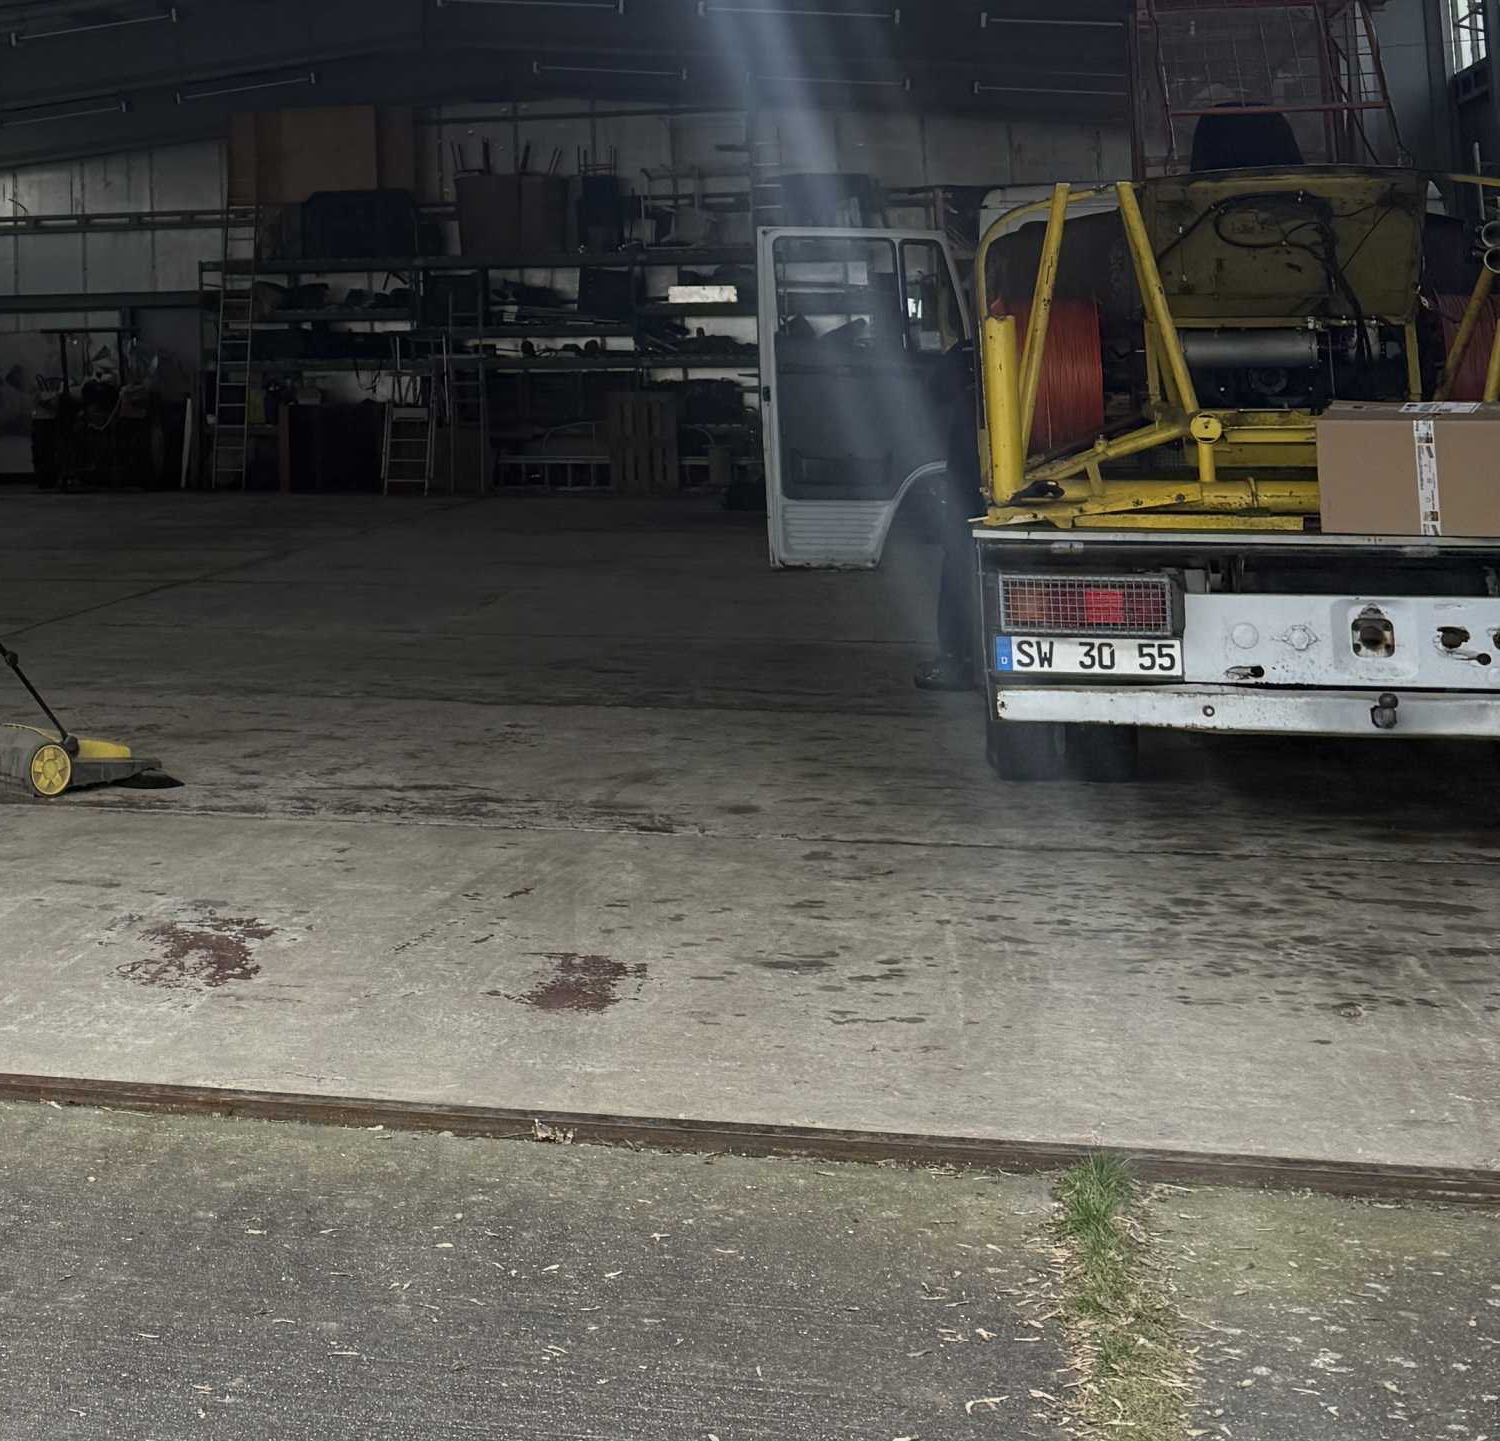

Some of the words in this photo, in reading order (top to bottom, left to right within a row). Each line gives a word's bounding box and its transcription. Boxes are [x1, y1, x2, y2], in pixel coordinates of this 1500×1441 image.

[1016, 640, 1054, 668] SW
[1078, 642, 1116, 670] 30
[1137, 643, 1176, 672] 55
